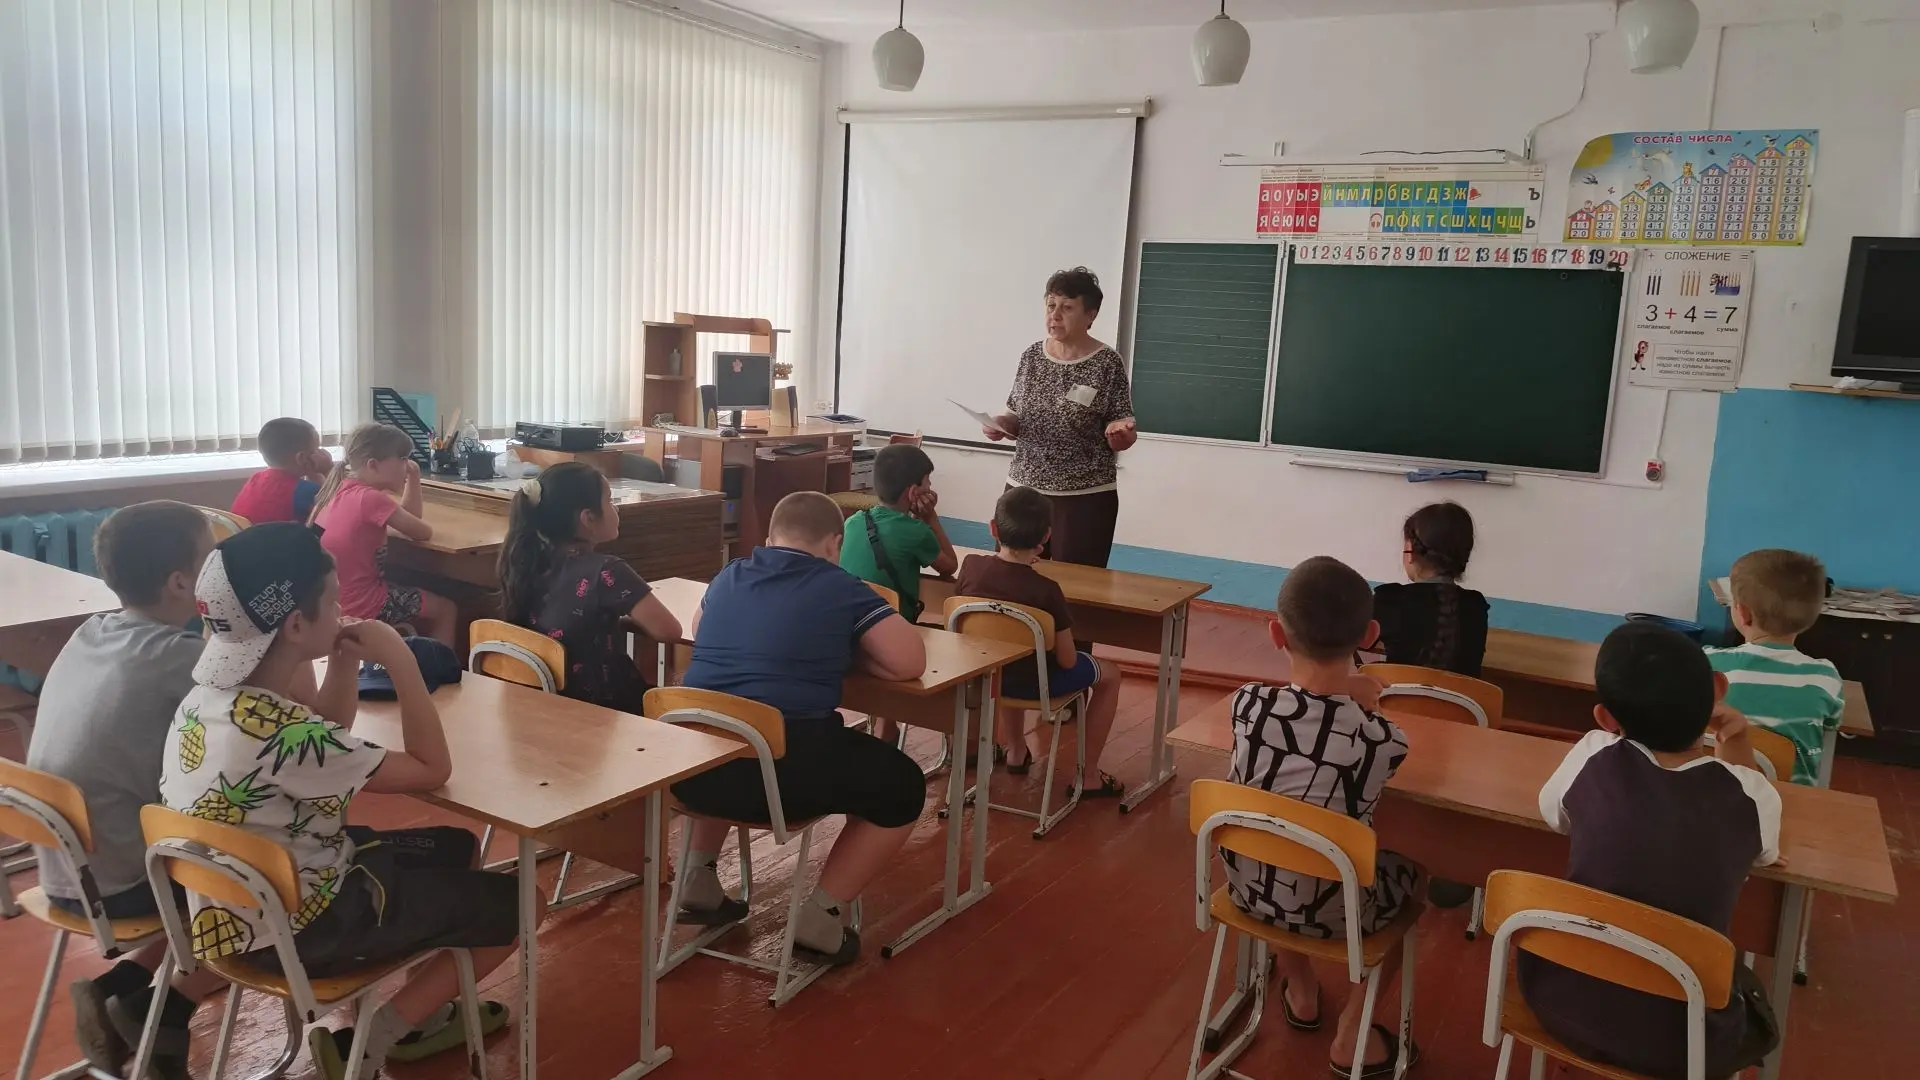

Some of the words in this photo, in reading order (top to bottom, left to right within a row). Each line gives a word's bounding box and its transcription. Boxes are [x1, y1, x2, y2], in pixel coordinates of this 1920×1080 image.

[1634, 135, 1682, 144] СОСТАВ
[1688, 135, 1733, 143] ЧИСЛА
[1300, 246, 1308, 259] 0
[1311, 245, 1318, 259] 1
[1320, 246, 1330, 260] 2
[1332, 246, 1341, 260] 3
[1344, 246, 1353, 260] 4
[1356, 246, 1366, 260] 5
[1369, 247, 1378, 260] 6
[1381, 247, 1390, 260] 7
[1393, 247, 1402, 260] 8
[1406, 247, 1415, 260] 9
[1419, 247, 1432, 261] 10
[1437, 247, 1449, 261] 11
[1455, 247, 1470, 262] 12
[1476, 247, 1490, 262] 13
[1494, 248, 1509, 262] 14
[1513, 248, 1527, 263] 15
[1531, 248, 1547, 263] 16
[1551, 249, 1567, 263] 17
[1570, 249, 1585, 264] 18
[1588, 249, 1605, 264] 19
[1608, 250, 1628, 266] 20
[1665, 252, 1731, 260] СЛОЖЕНИЕ
[1646, 305, 1658, 322] 3
[1684, 306, 1696, 322] 4
[1725, 307, 1737, 324] 7
[249, 580, 278, 608] STUDY
[252, 594, 278, 615] NOW
[280, 580, 293, 593] BE
[260, 592, 293, 620] PROUD
[265, 599, 296, 626] LATER
